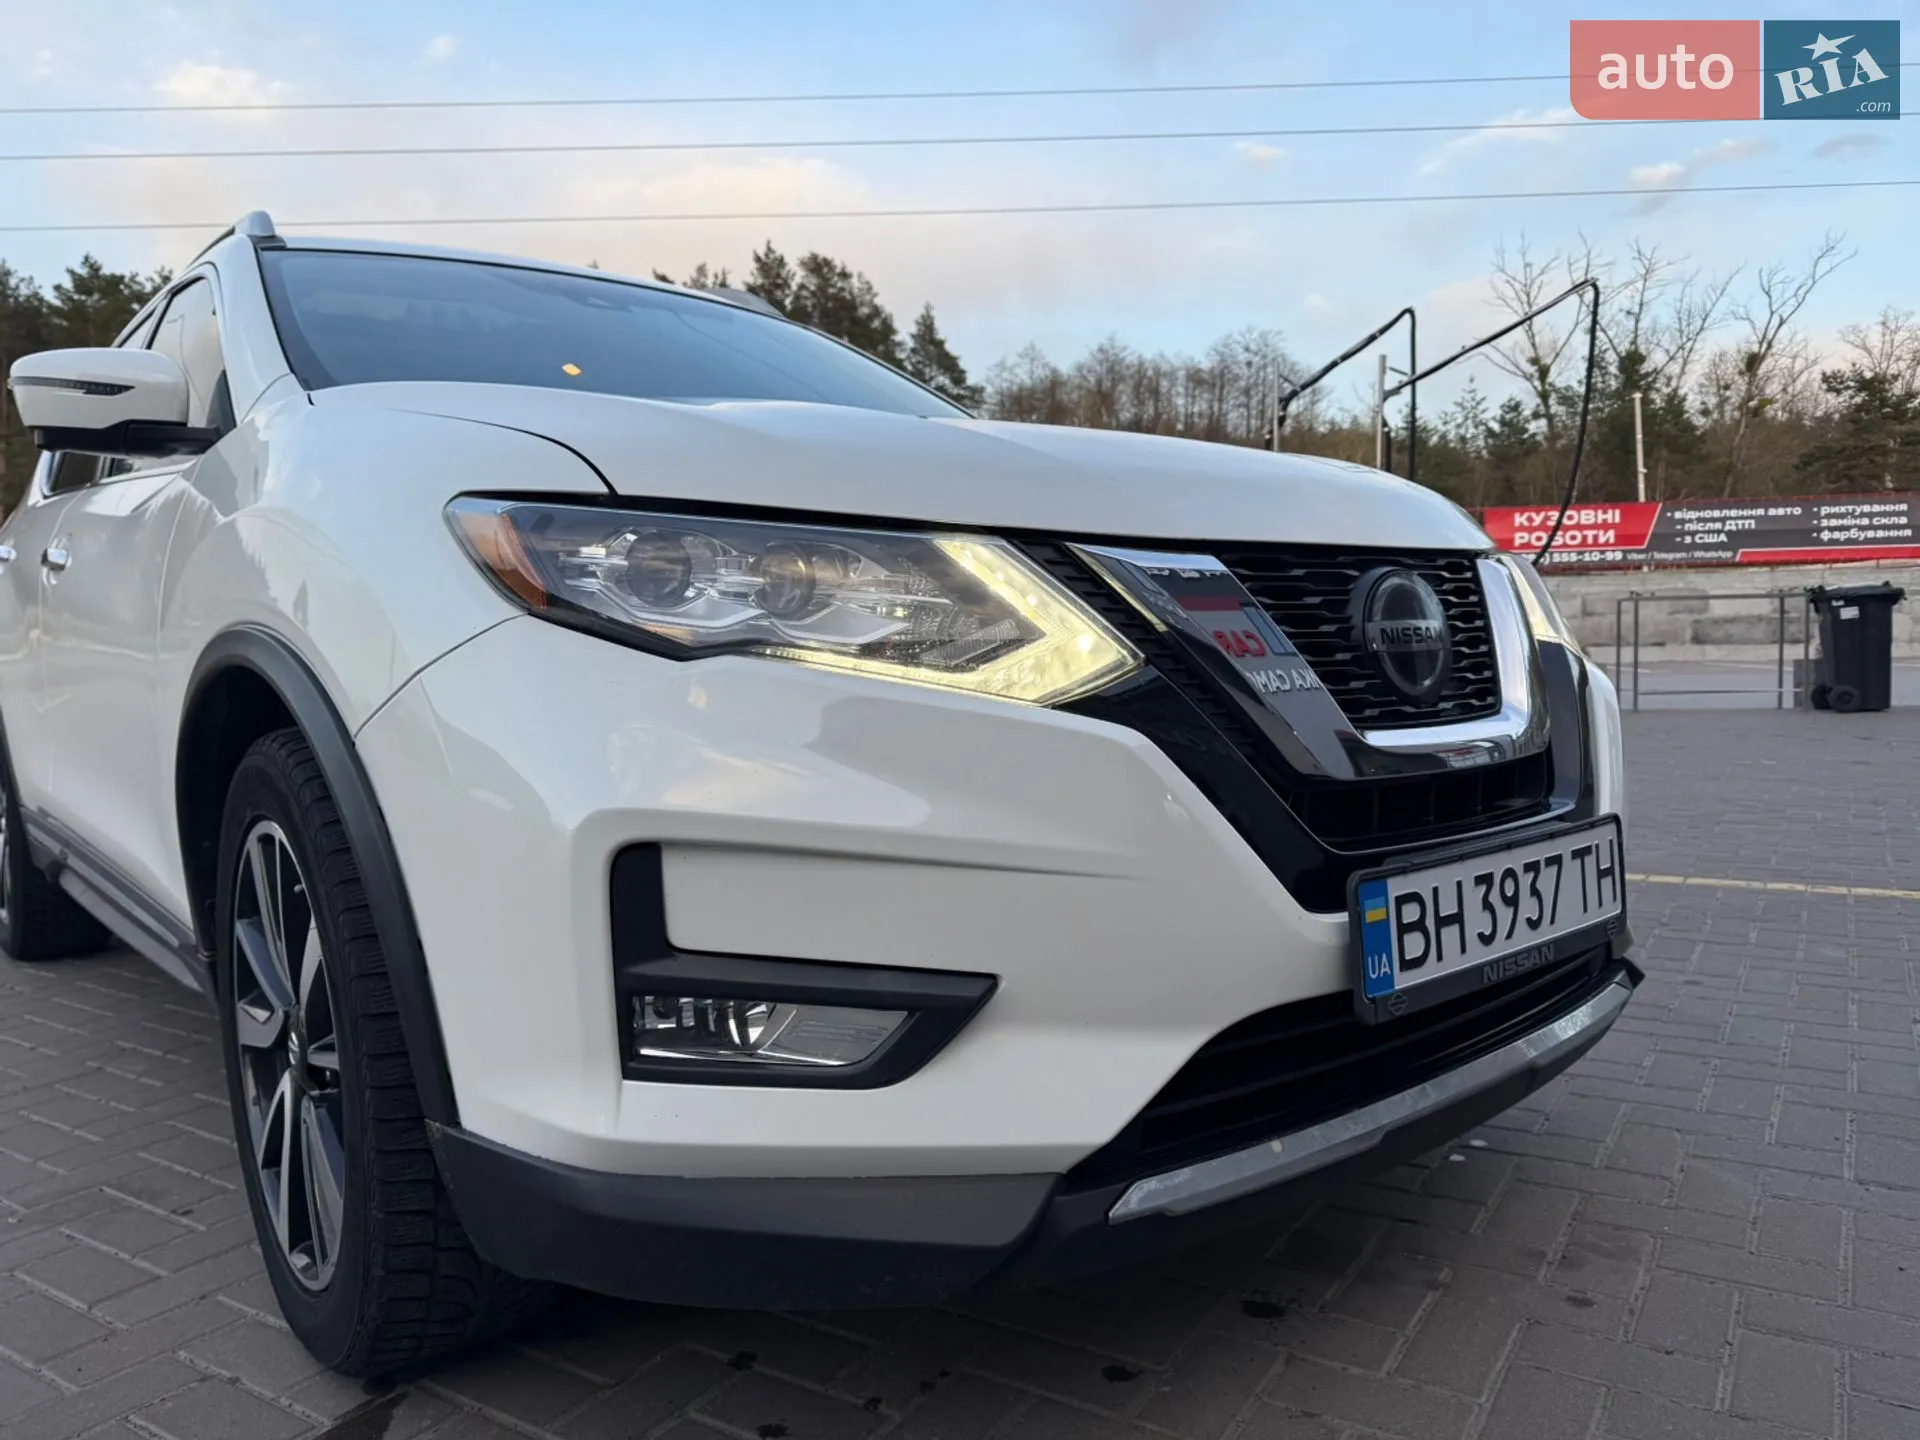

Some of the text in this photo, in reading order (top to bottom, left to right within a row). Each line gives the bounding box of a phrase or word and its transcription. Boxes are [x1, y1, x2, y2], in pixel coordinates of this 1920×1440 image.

[1674, 506, 1802, 520] відновлення авто
[1820, 503, 1908, 516] рихтування
[1513, 509, 1621, 527] КУЗОВНІ
[1683, 519, 1756, 532] після ДТП
[1820, 515, 1908, 527] заміна скла
[1513, 530, 1616, 547] РОБОТИ
[1694, 533, 1728, 544] США
[1820, 528, 1912, 541] фарбування
[1380, 625, 1443, 645] NISSAN
[1474, 852, 1563, 947] 3937
[1367, 952, 1391, 980] UA
[1482, 945, 1554, 984] NISSAN
